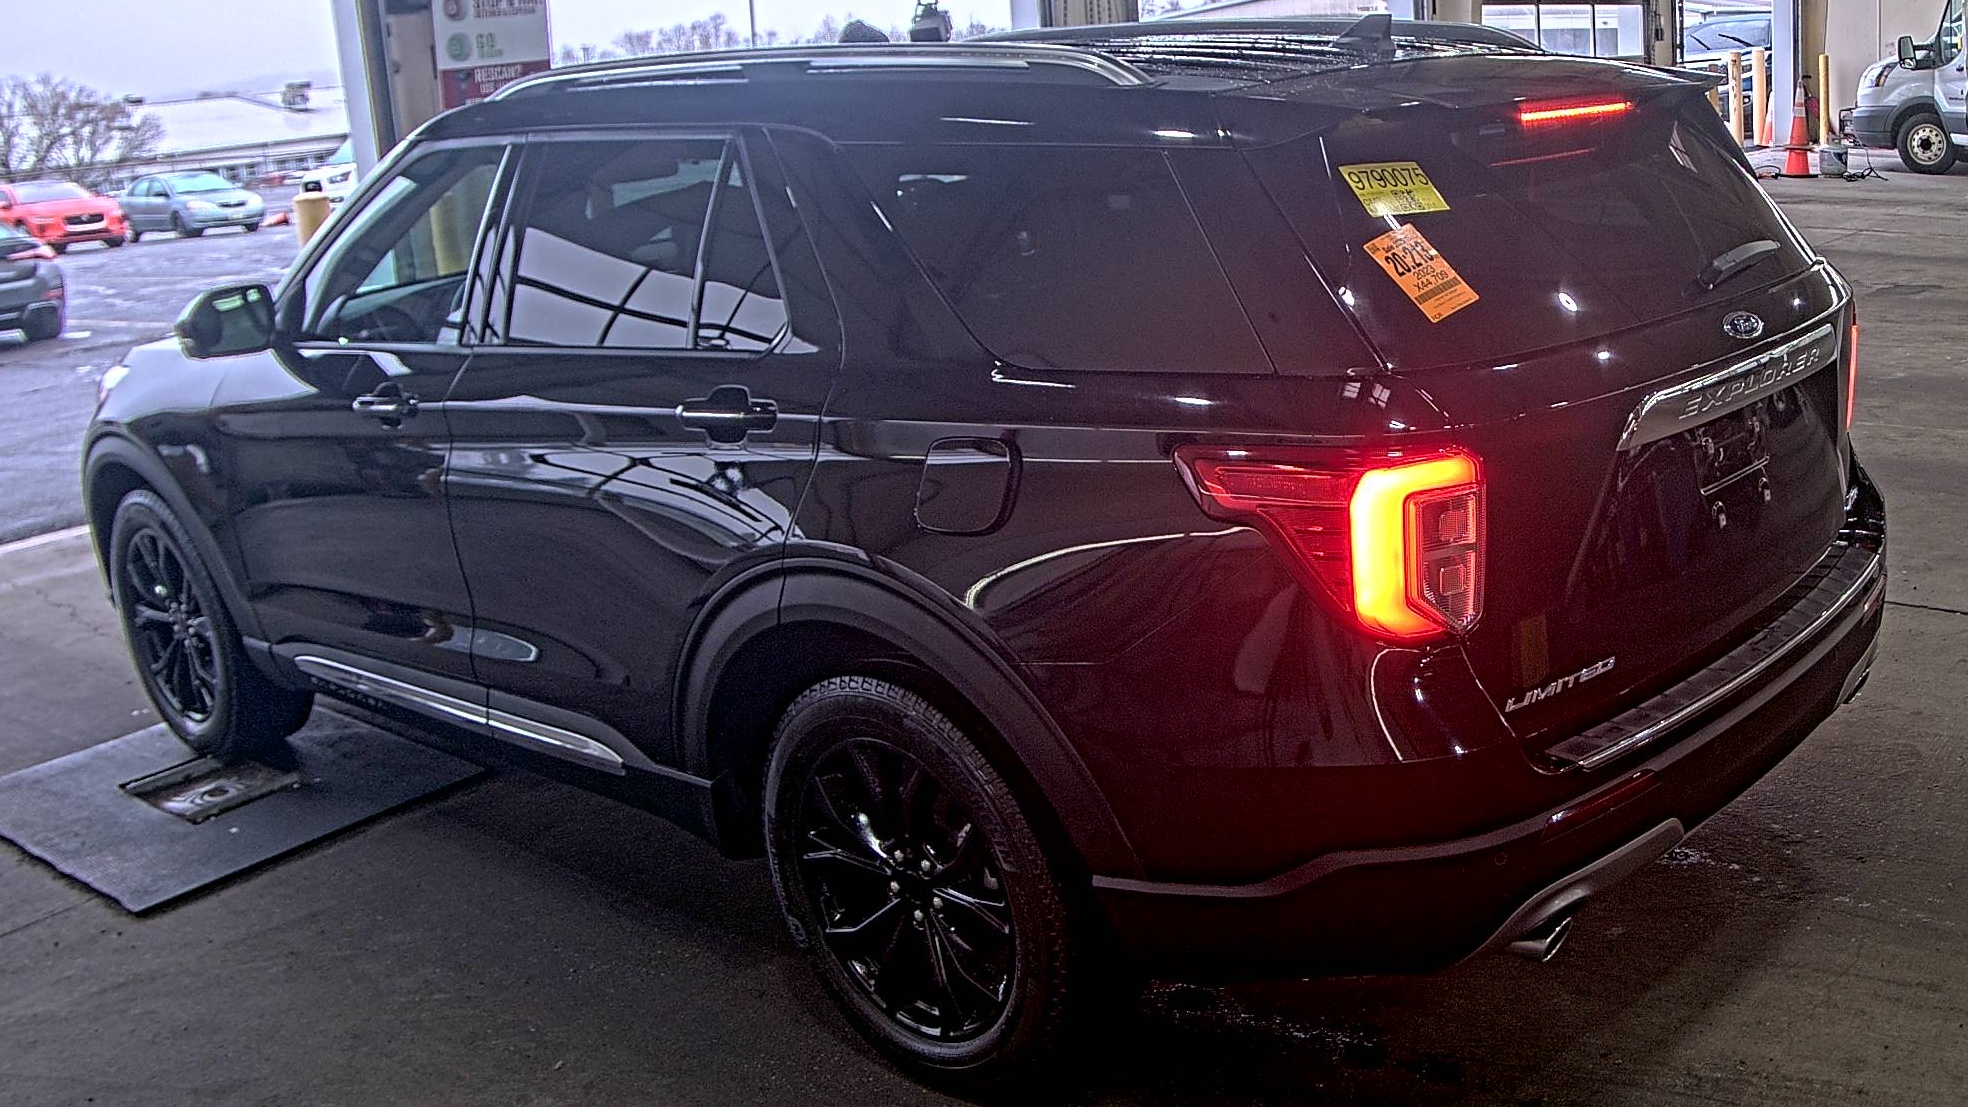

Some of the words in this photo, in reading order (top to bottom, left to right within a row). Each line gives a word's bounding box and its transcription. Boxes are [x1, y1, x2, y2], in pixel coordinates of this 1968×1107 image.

[1347, 167, 1429, 190] 9790075
[1412, 264, 1436, 281] 2023
[1413, 269, 1450, 292] X44,709
[1678, 347, 1820, 420] EXPLORER
[1504, 656, 1616, 713] LIMITED
